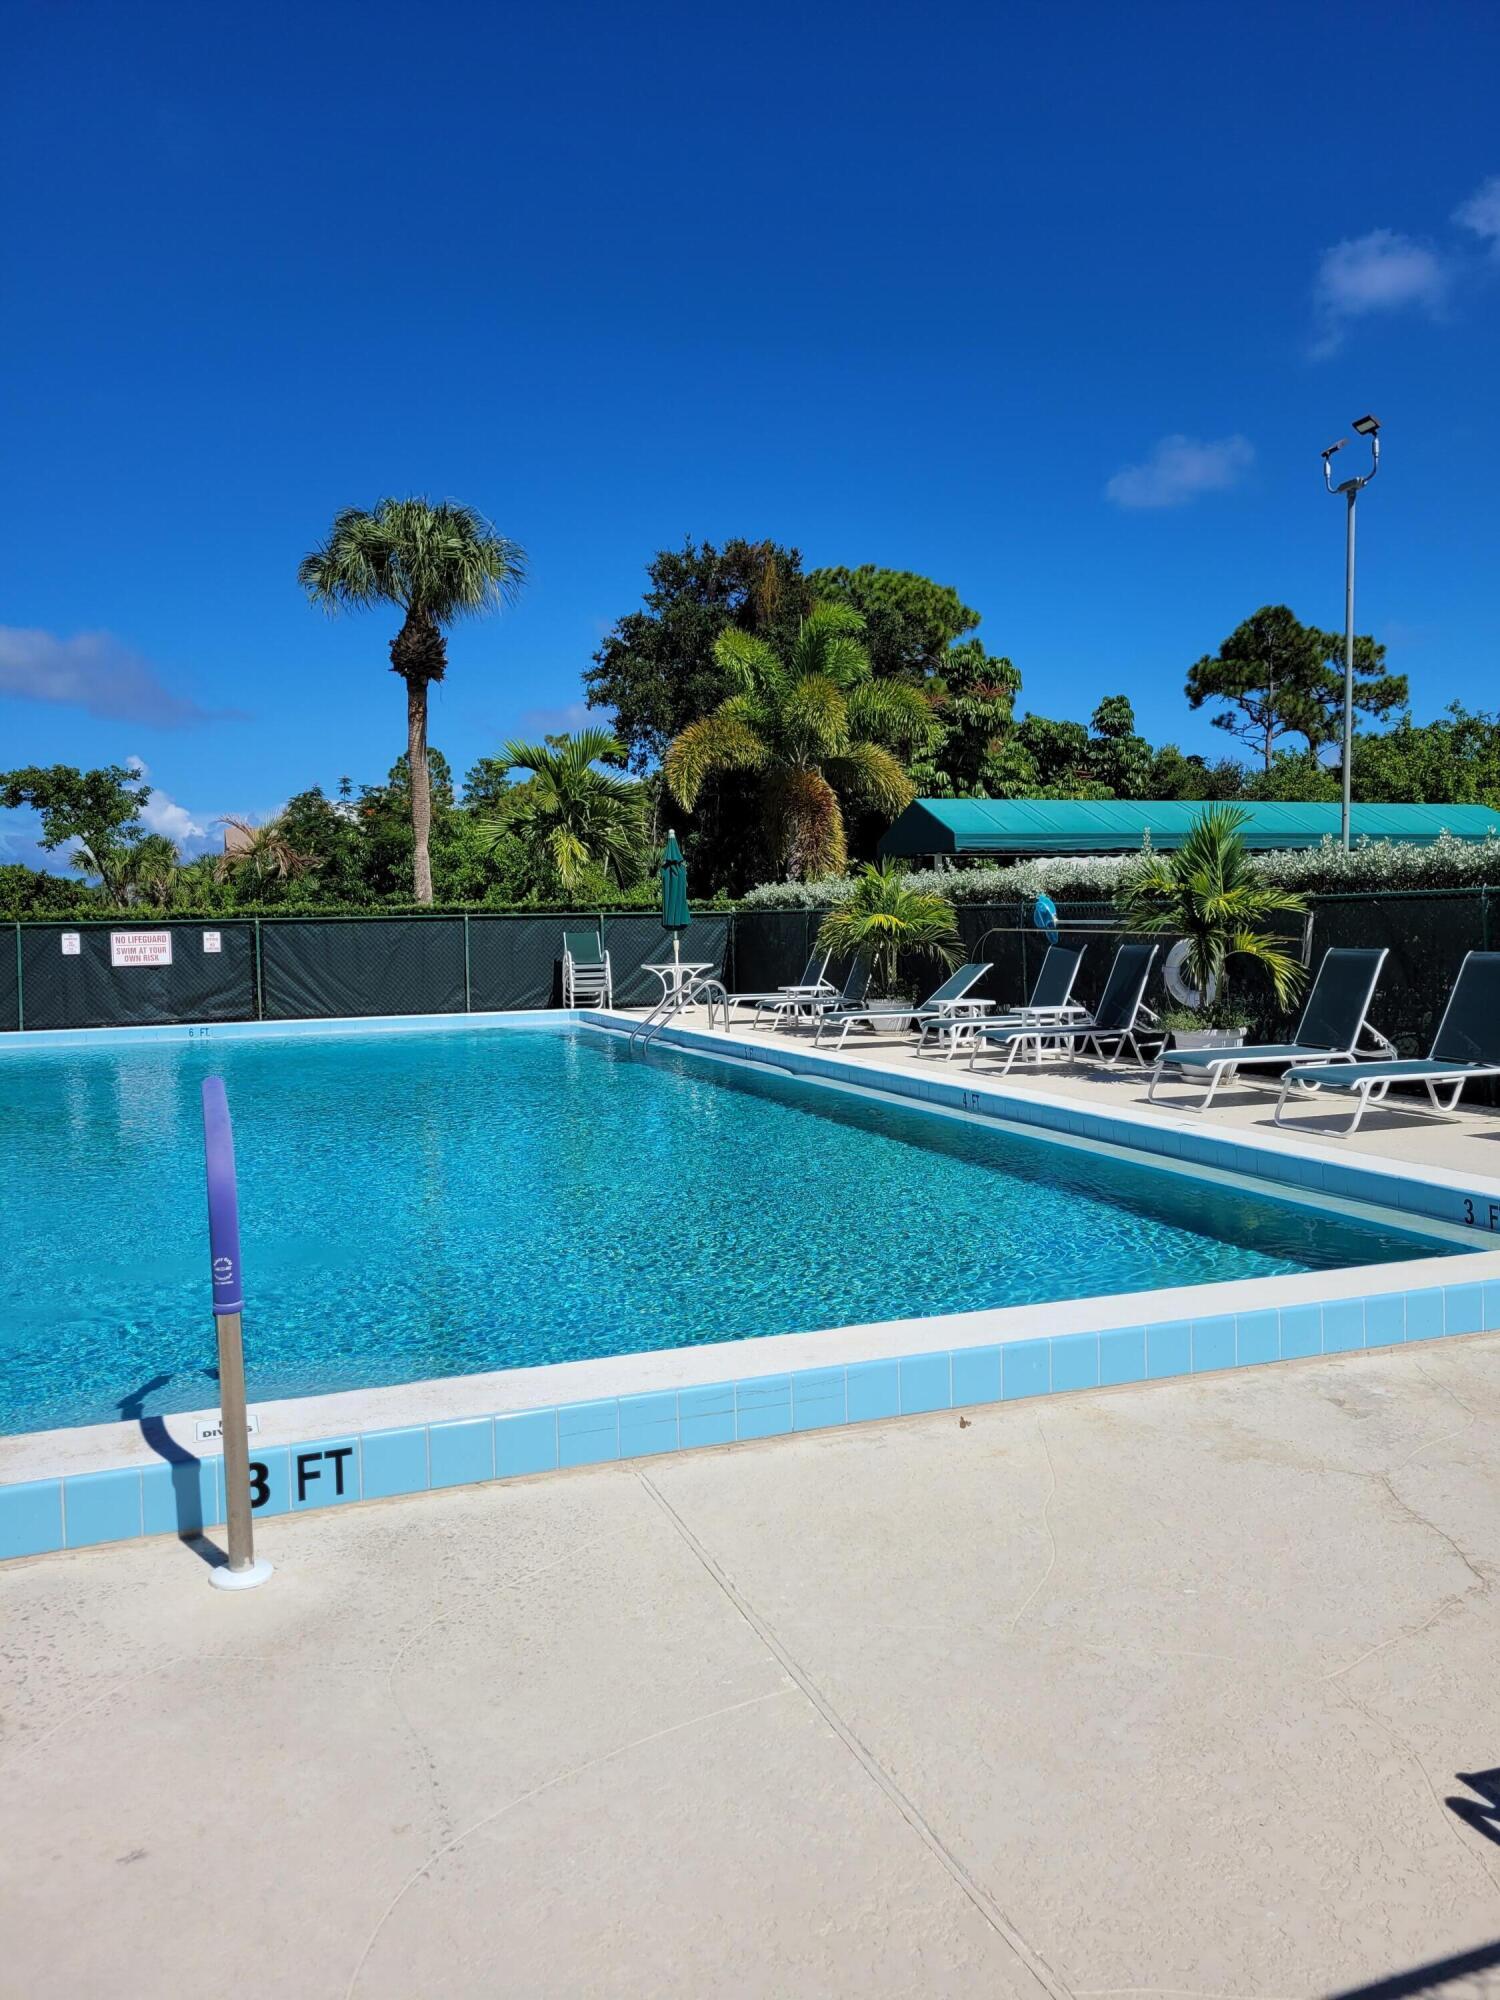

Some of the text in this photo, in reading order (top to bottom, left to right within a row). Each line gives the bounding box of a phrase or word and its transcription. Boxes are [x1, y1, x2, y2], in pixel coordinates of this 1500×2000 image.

[115, 935, 167, 944] NO LIFEGUARD
[116, 946, 167, 955] SWIM AT YOUR
[124, 953, 160, 962] OWN RISK
[189, 1027, 210, 1037] 6 FT
[1463, 1198, 1500, 1230] 3 F
[297, 1447, 353, 1502] FT
